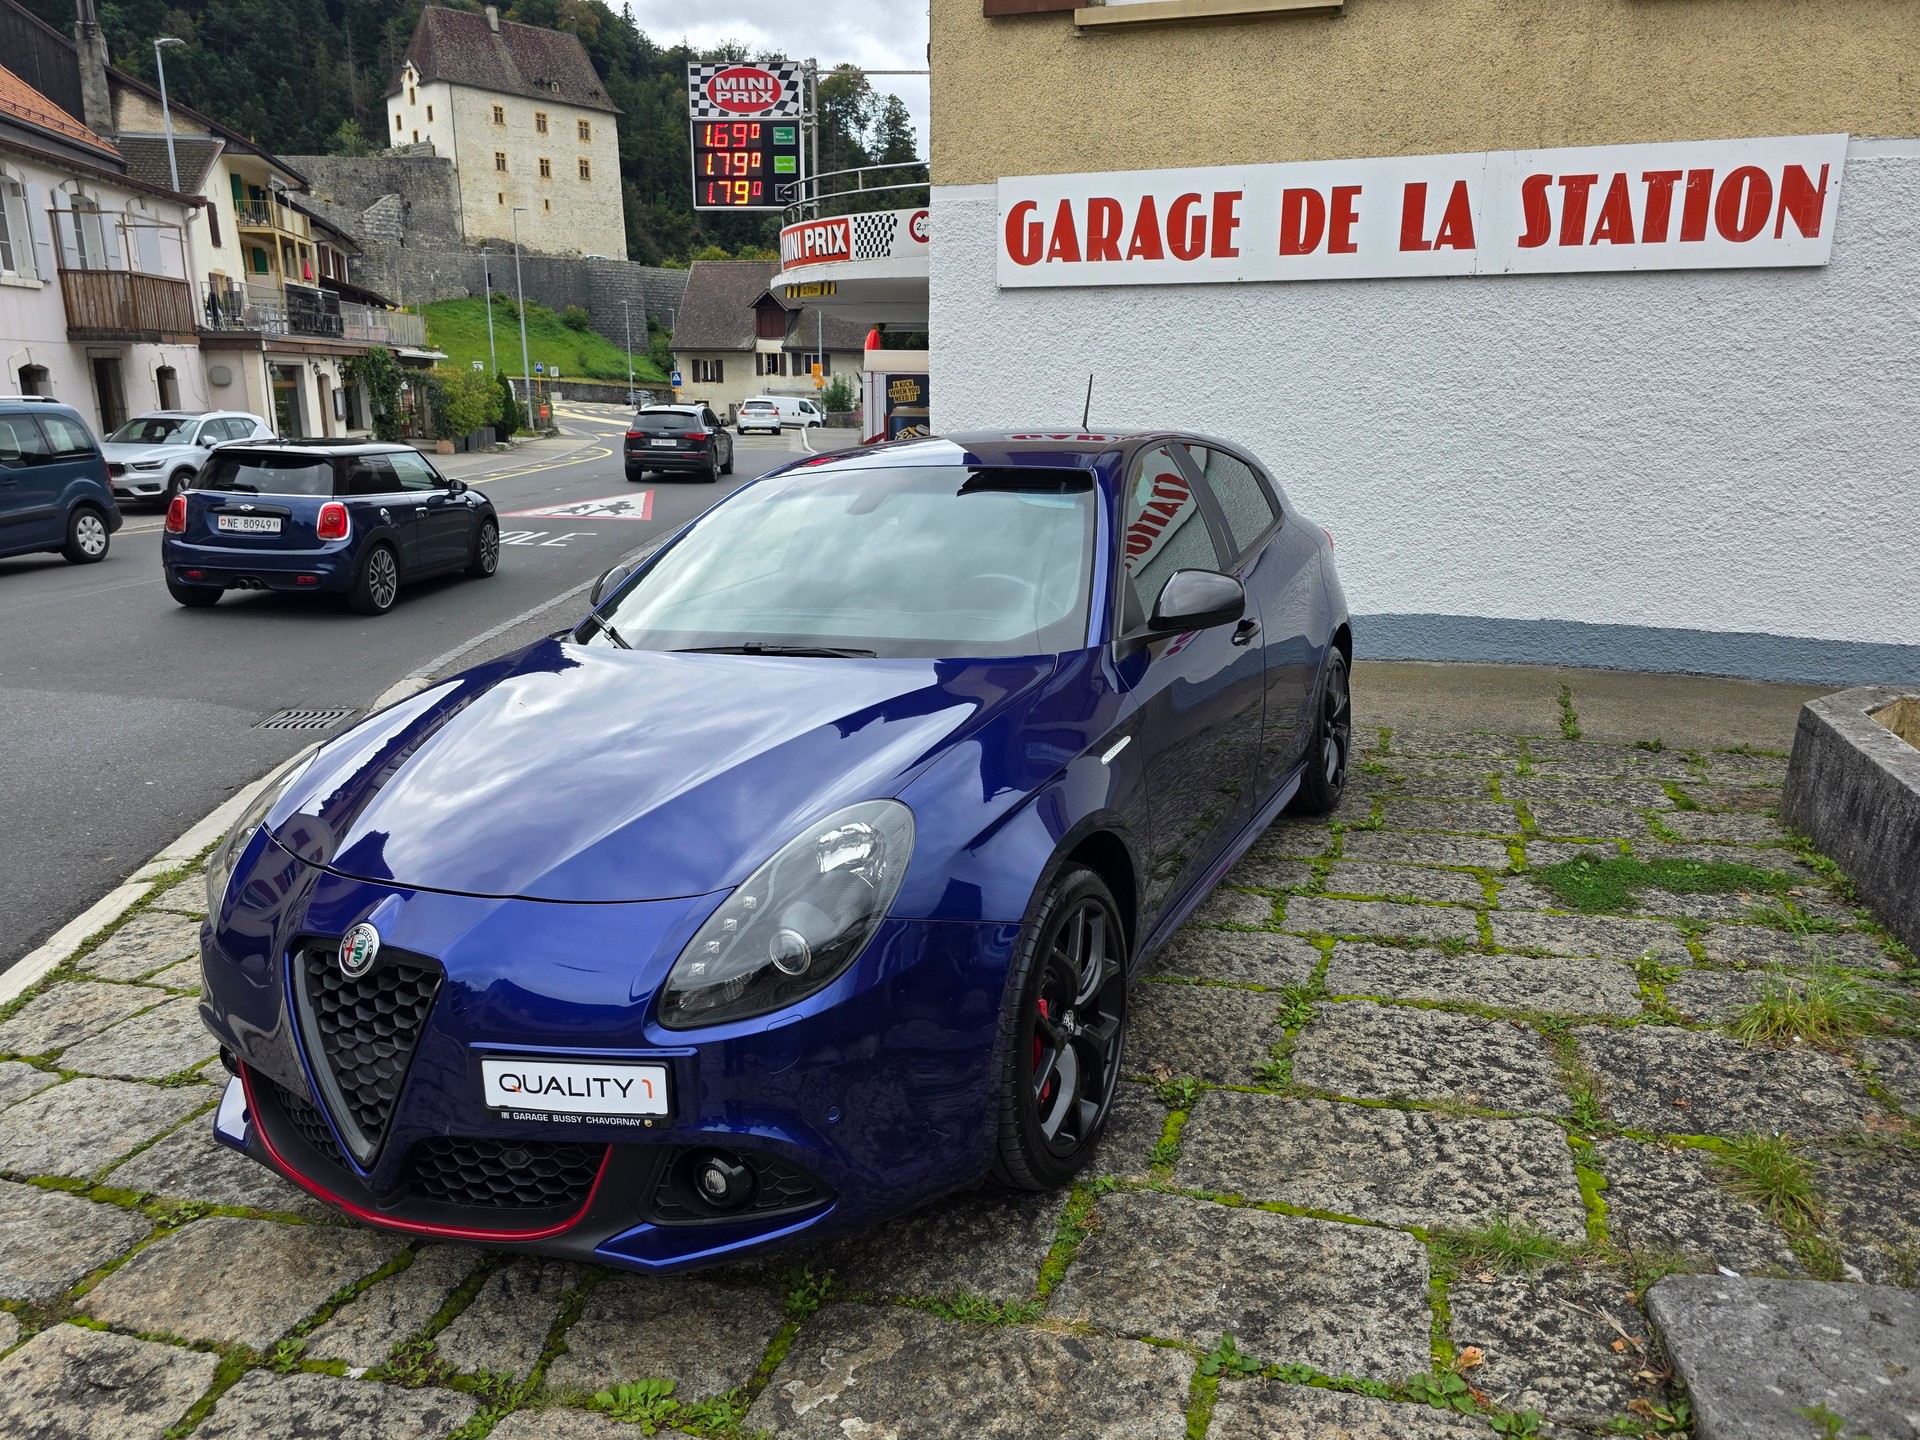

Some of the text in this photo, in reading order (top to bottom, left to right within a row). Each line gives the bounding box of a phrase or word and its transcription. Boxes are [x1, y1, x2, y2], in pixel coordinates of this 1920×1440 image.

[715, 77, 773, 90] MINI
[716, 91, 775, 103] PRIX
[1005, 163, 1830, 266] GARAGE DE LA STATION
[782, 223, 848, 262] MINI PRIX
[889, 386, 920, 397] WHEN YOU
[899, 380, 913, 388] KICK
[359, 929, 373, 953] ROMEO
[498, 1073, 653, 1099] QUALITY 1
[512, 1112, 549, 1122] GARAGE
[552, 1114, 582, 1124] BUSSY
[585, 1116, 641, 1127] CHAVORNAY
